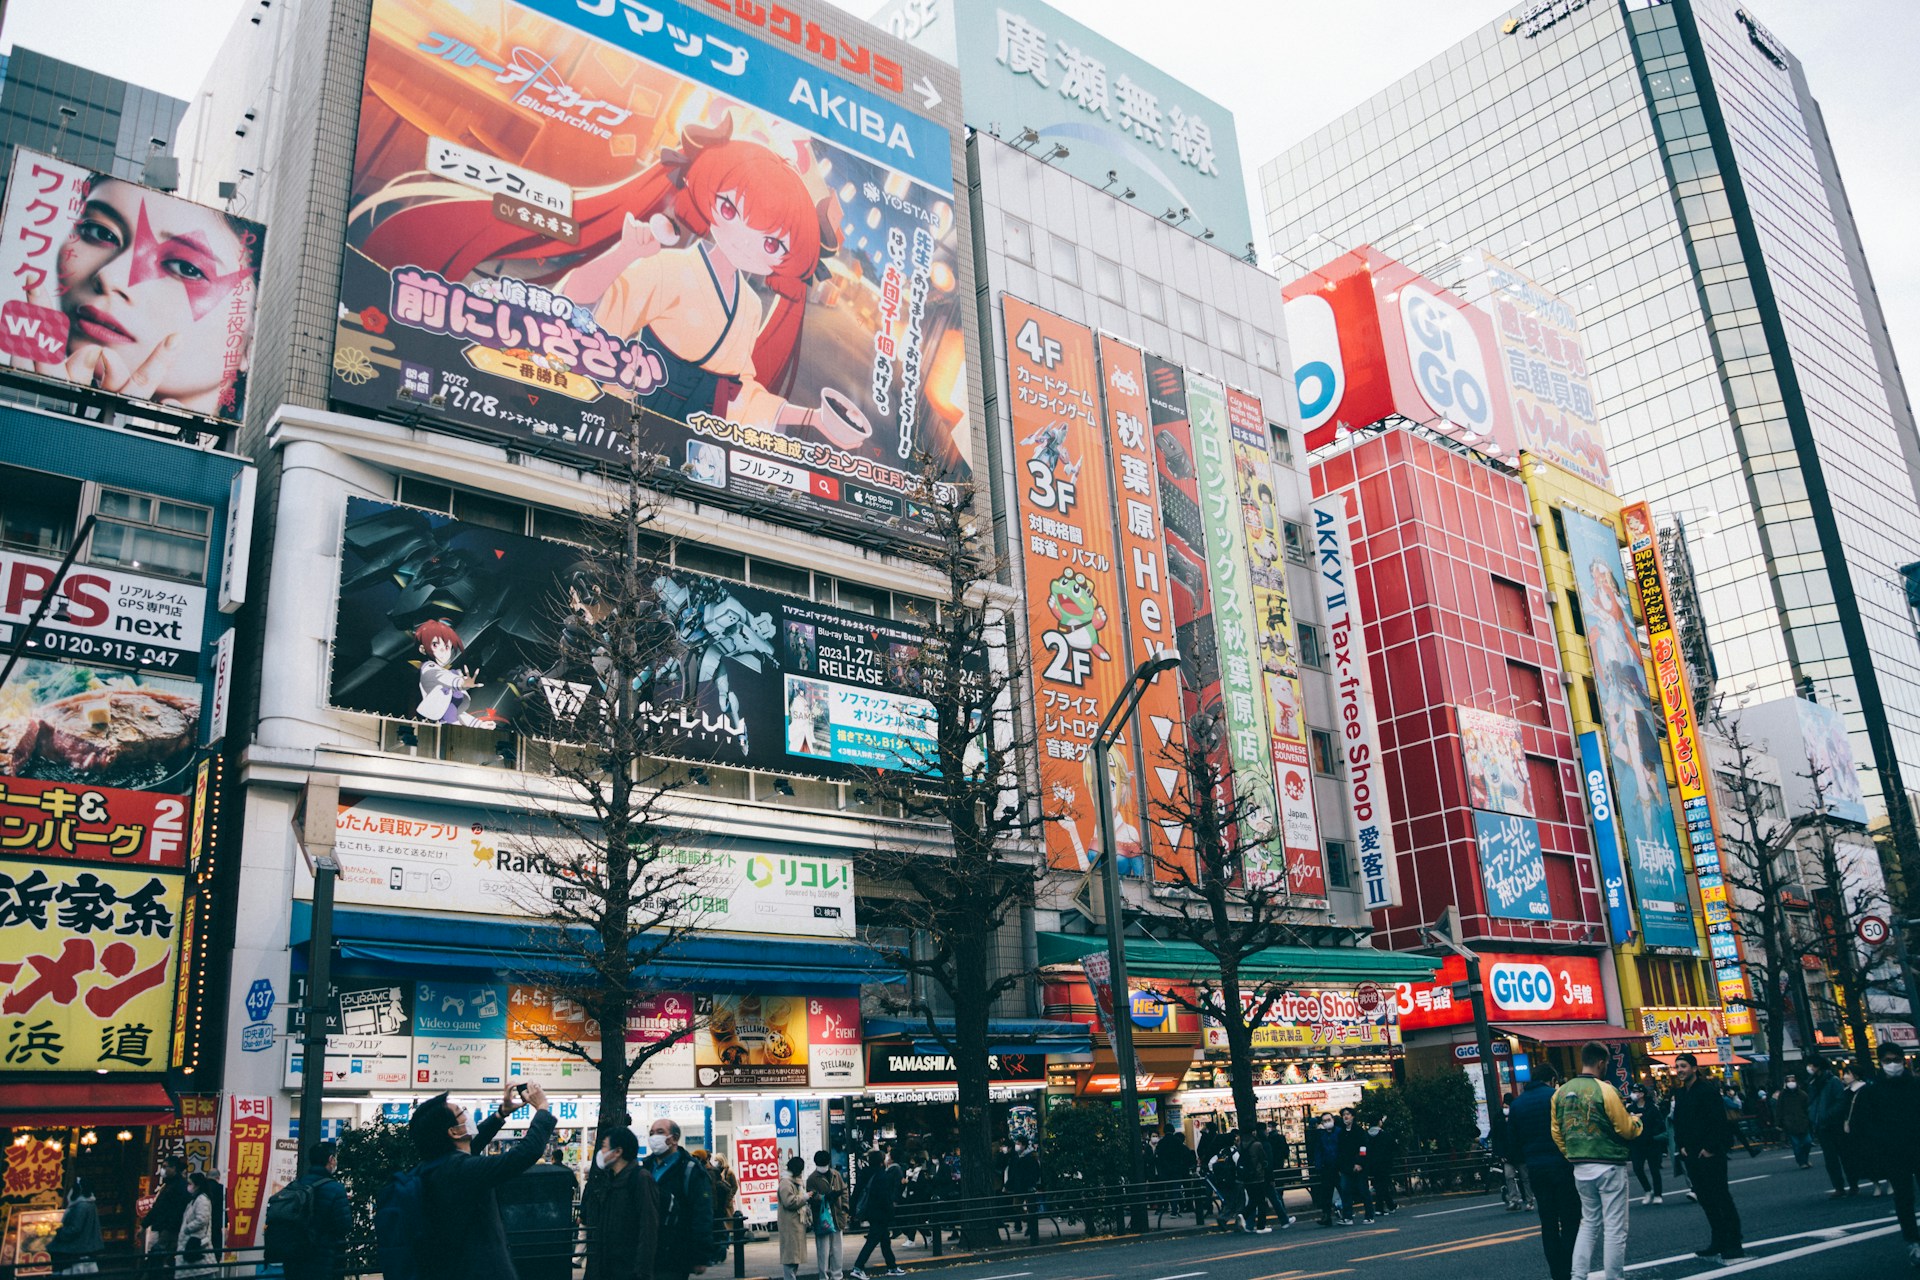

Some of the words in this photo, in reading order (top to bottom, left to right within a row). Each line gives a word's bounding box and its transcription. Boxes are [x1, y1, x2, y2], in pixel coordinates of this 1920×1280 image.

[516, 95, 613, 140] BlueArchive
[788, 77, 916, 160] AKIBA
[13, 164, 65, 292] ワクワク
[217, 229, 258, 413] わたしが主役の世界線。
[1016, 318, 1062, 369] 4F
[442, 370, 470, 387] 2022
[501, 361, 569, 390] 一番勝負
[1017, 365, 1094, 407] カードゲーム
[1018, 386, 1097, 428] オンラインゲーム
[738, 458, 795, 485] ブルアカ
[1027, 459, 1076, 514] 3F
[1028, 513, 1083, 545] 対戦格闘
[1030, 535, 1110, 573] 麻雀・パズル
[1635, 549, 1653, 562] DVD
[1638, 567, 1657, 580] ゲーム
[1643, 577, 1656, 588] CD
[1198, 406, 1259, 762] メロンブックス秋葉原店
[118, 584, 188, 606] リアルタイム
[1644, 593, 1663, 607] アニメ
[118, 597, 183, 618] GPS専門店
[115, 614, 183, 640] next
[817, 627, 843, 641] Blu-ray
[843, 632, 857, 642] Box
[818, 644, 874, 666] 2023.1.27
[1042, 629, 1092, 687] 2F
[818, 660, 884, 686] RELEASE
[1313, 508, 1345, 587] AKKY
[1331, 612, 1362, 740] Tax-free
[1349, 743, 1373, 822] Shop
[1043, 689, 1099, 717] プライズ
[1274, 741, 1307, 755] JAPANESE
[1274, 751, 1308, 764] SOUVENIR
[1587, 770, 1609, 821] GiGO
[1688, 810, 1708, 821] DVD
[149, 798, 185, 862] 2F
[1287, 820, 1312, 832] Tax-free
[1479, 815, 1524, 859] ゲームの
[1692, 831, 1713, 844] DVD
[1483, 830, 1536, 891] オアシスに
[1696, 853, 1718, 865] DVD
[780, 858, 848, 890] リコレ!
[785, 888, 809, 898] powered
[809, 890, 817, 900] by
[1605, 876, 1622, 908] 3号館
[1529, 901, 1549, 915] GiGO
[1863, 923, 1883, 937] 50
[1713, 945, 1737, 957] DVD
[419, 985, 436, 1002] 3F
[1493, 969, 1552, 1004] GiGO
[1559, 970, 1594, 1005] 3号館
[248, 990, 273, 1010] 437
[698, 997, 712, 1013] 7F
[810, 1000, 823, 1015] 8F
[1132, 998, 1166, 1018] Hey
[419, 1016, 450, 1029] Video
[451, 1019, 481, 1031] game
[243, 1026, 272, 1041] 中央通り
[835, 1028, 856, 1039] EVENT
[326, 1039, 383, 1050] ビーのフロア
[430, 1041, 487, 1052] ゲームのフロア
[1492, 1044, 1509, 1054] GiGO
[820, 1060, 855, 1071] STELLAMAP
[875, 1093, 897, 1103] Best
[897, 1091, 925, 1102] Global
[927, 1090, 954, 1101] Action
[988, 1089, 1013, 1099] Brand
[238, 1098, 265, 1115] 本日
[234, 1123, 271, 1140] フェア
[739, 1143, 775, 1160] Tax
[739, 1160, 778, 1179] Free
